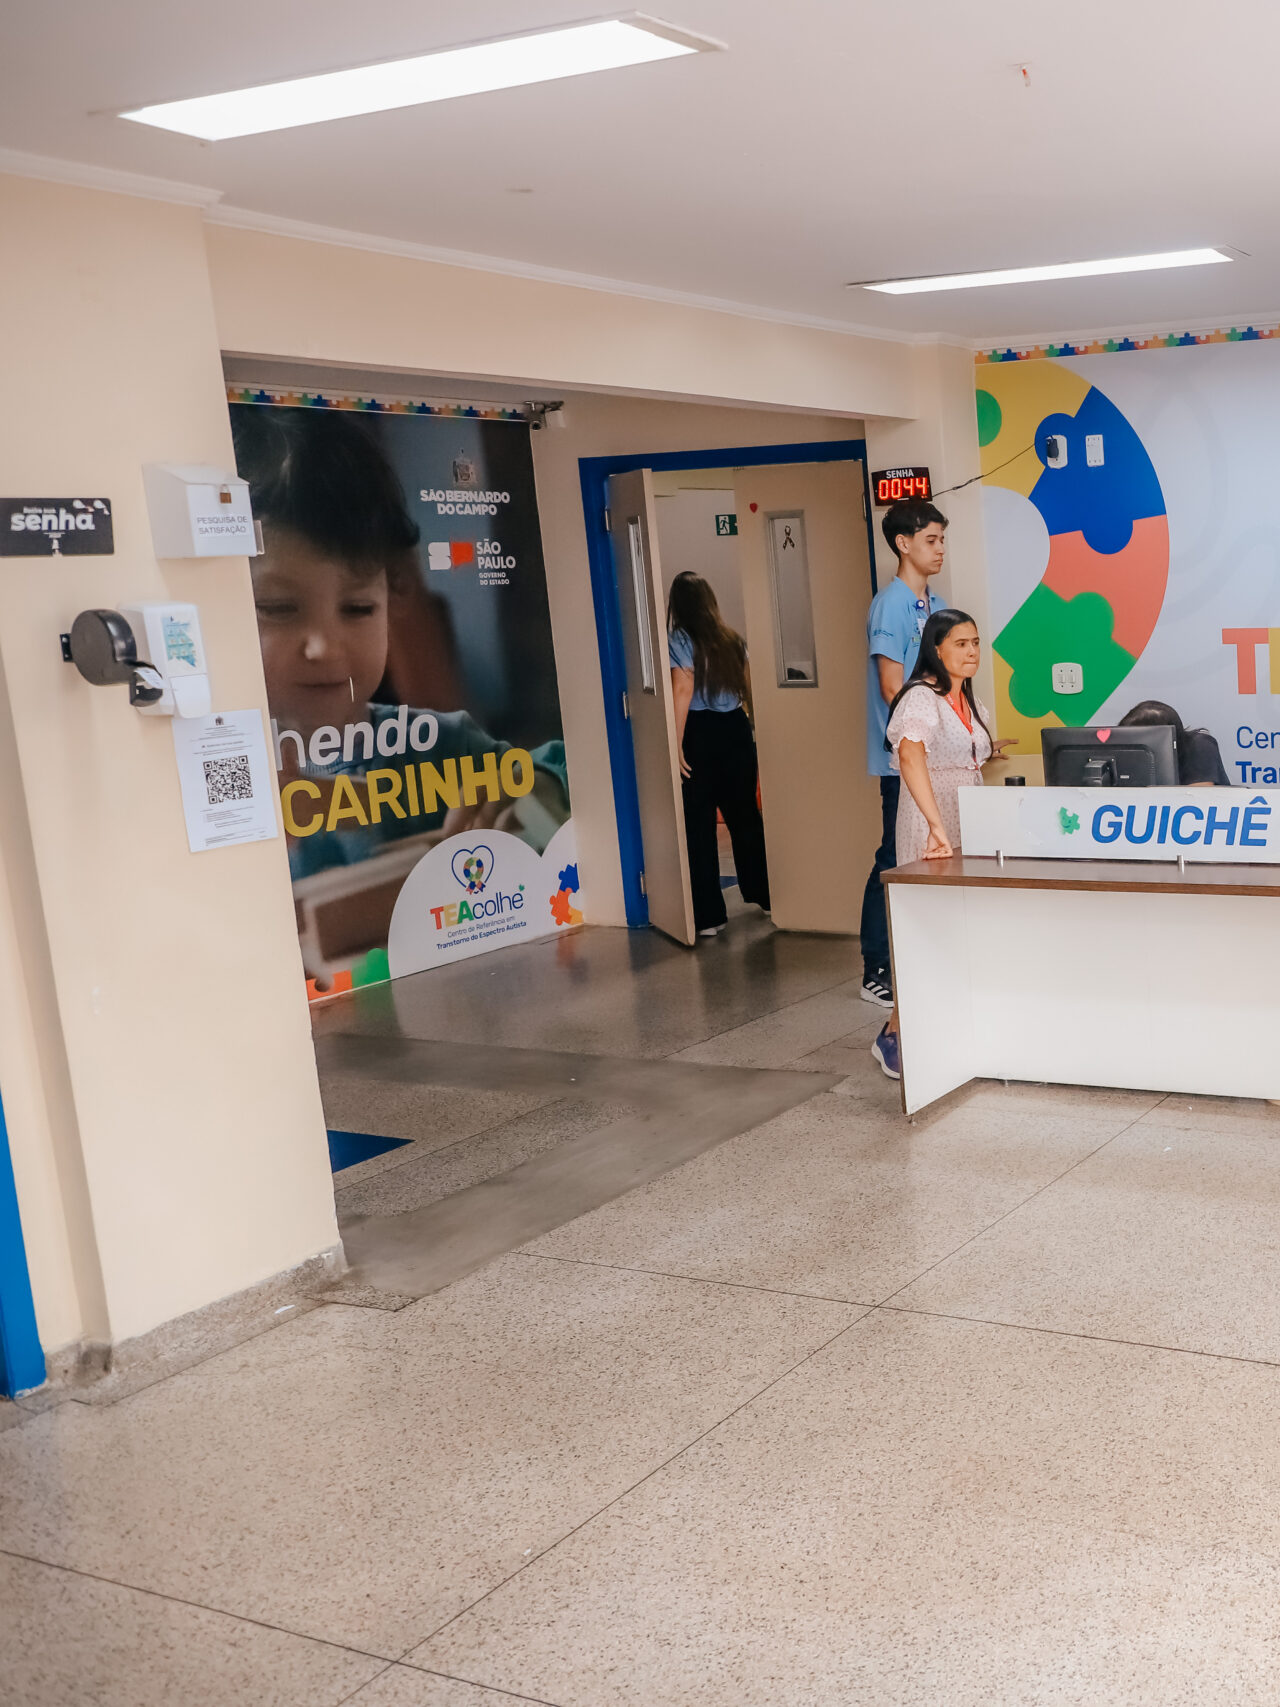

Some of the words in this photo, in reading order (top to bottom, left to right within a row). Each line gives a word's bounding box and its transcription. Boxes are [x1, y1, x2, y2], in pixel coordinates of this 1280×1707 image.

[886, 469, 914, 479] SENHA
[420, 489, 445, 502] SÃO
[446, 490, 510, 503] BERNARDO
[879, 477, 928, 500] 0044
[437, 503, 455, 515] DO
[455, 503, 497, 515] CAMPO
[10, 507, 95, 532] senha
[476, 538, 501, 555] SÃO
[478, 556, 516, 569] PAULO
[280, 748, 535, 838] CARINHO
[1091, 796, 1272, 847] GUICHÊ
[430, 891, 524, 930] TEAcolhe
[448, 927, 467, 938] Centro
[468, 925, 475, 933] de
[471, 933, 478, 941] do
[480, 927, 505, 938] Espectro
[506, 920, 527, 931] Autista
